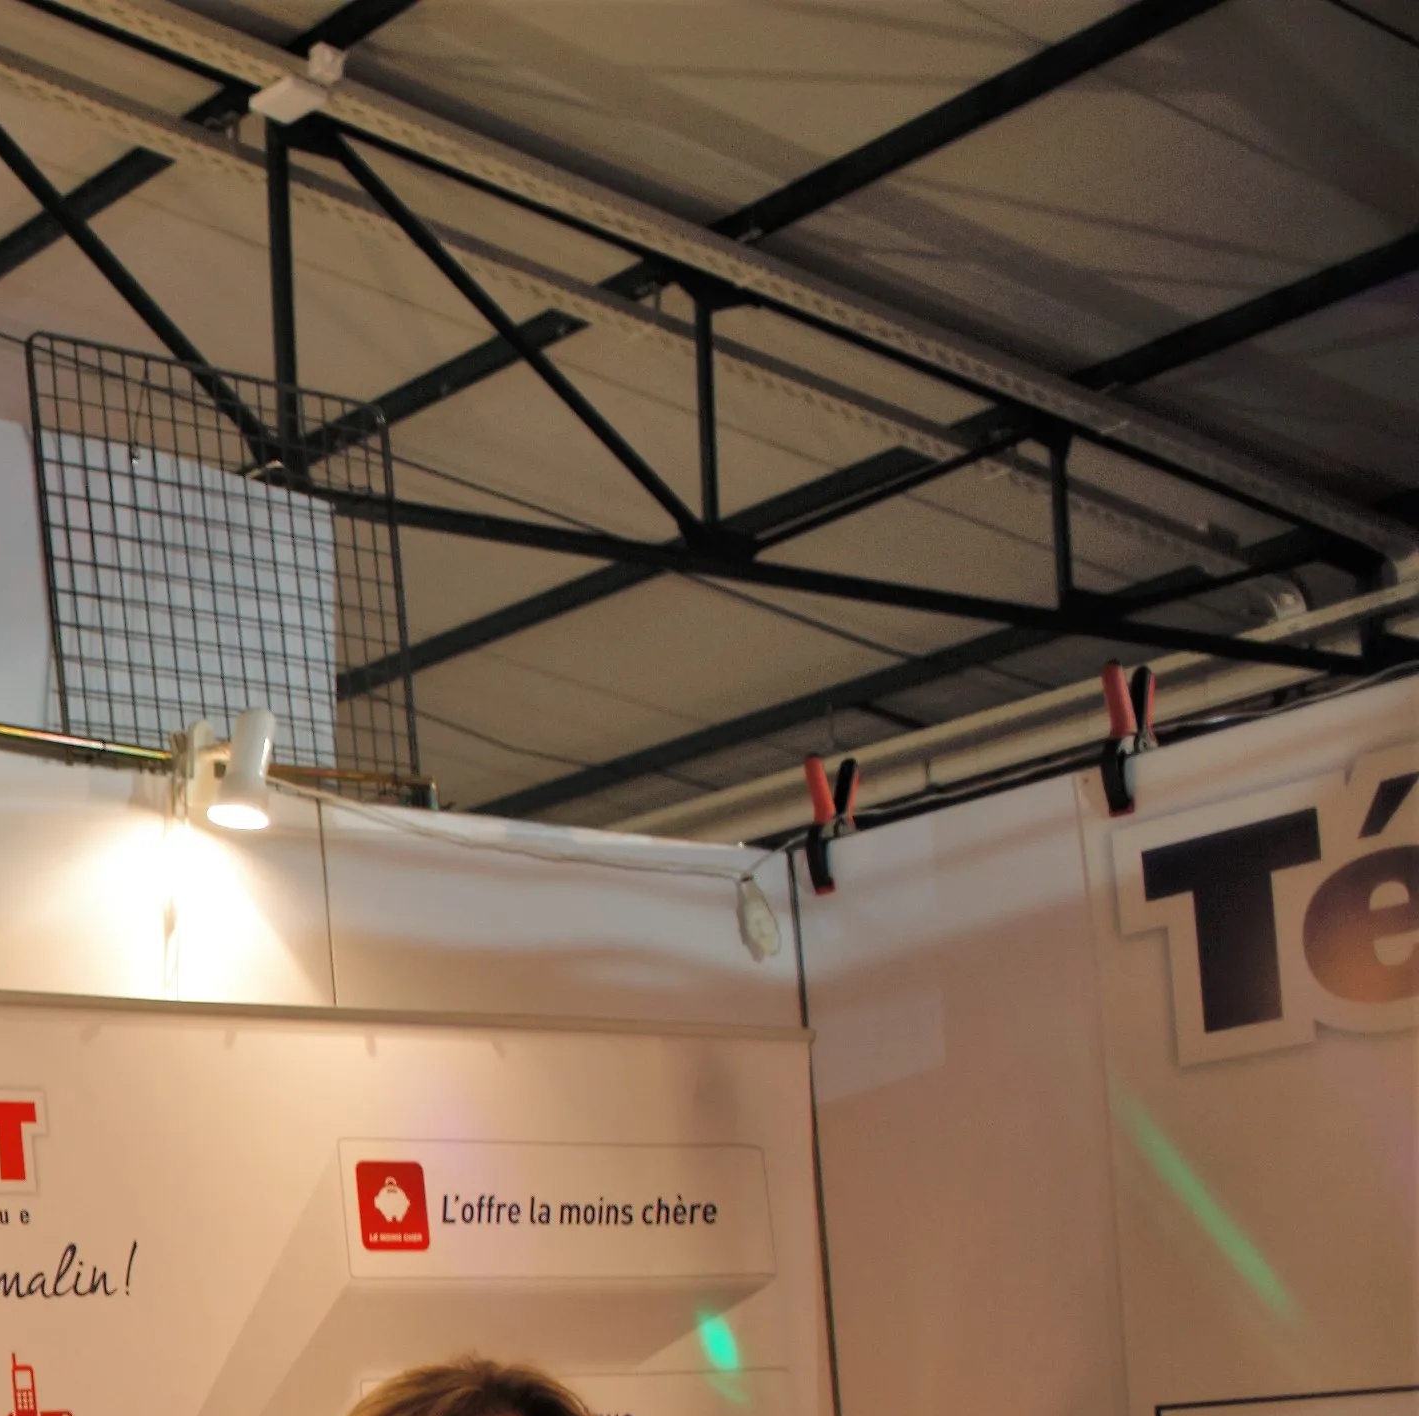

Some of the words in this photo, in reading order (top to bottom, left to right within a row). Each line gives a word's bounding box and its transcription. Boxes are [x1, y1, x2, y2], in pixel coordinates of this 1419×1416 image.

[441, 1195, 521, 1225] L'offre
[529, 1196, 551, 1225] la
[559, 1196, 633, 1226] moins
[642, 1194, 717, 1225] chère
